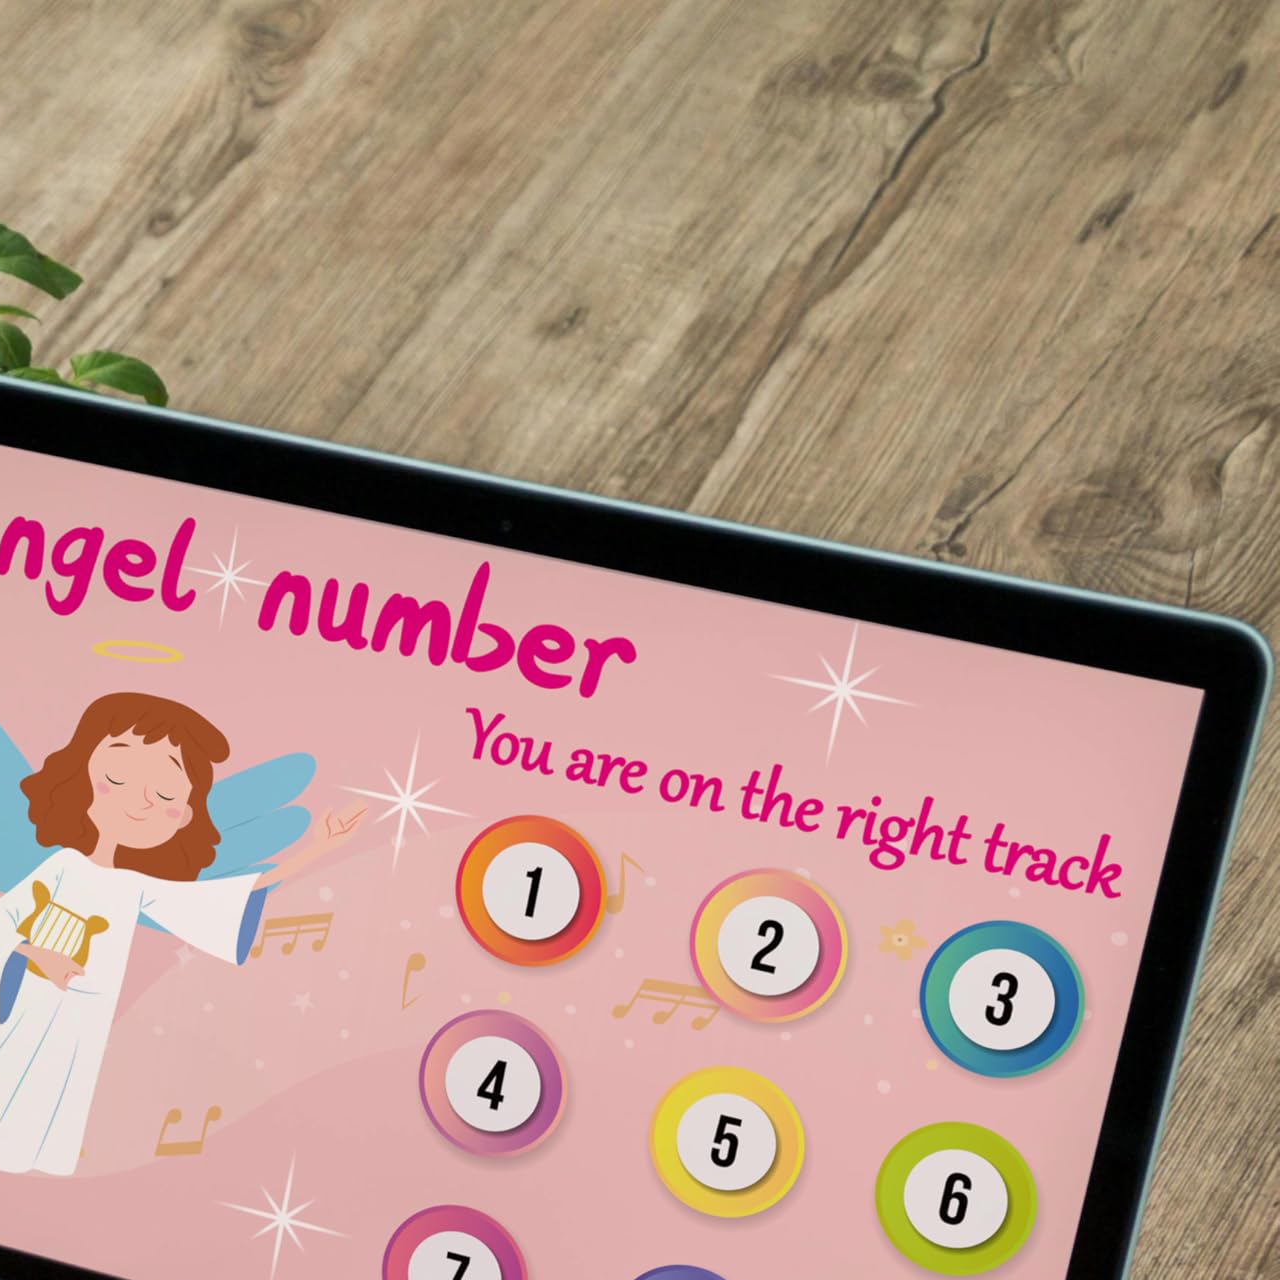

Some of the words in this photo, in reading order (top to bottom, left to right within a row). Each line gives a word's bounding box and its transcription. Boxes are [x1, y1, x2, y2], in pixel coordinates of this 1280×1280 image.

[258, 561, 637, 698] number
[466, 707, 553, 776] You
[565, 749, 648, 795] are
[659, 769, 724, 813] on
[741, 764, 824, 833] the
[837, 796, 972, 870] right
[984, 823, 1123, 899] track
[525, 867, 542, 917] 1
[751, 920, 783, 973] 2
[986, 973, 1018, 1026] 3
[477, 1061, 506, 1110] 4
[711, 1115, 742, 1167] 5
[940, 1173, 971, 1225] 6
